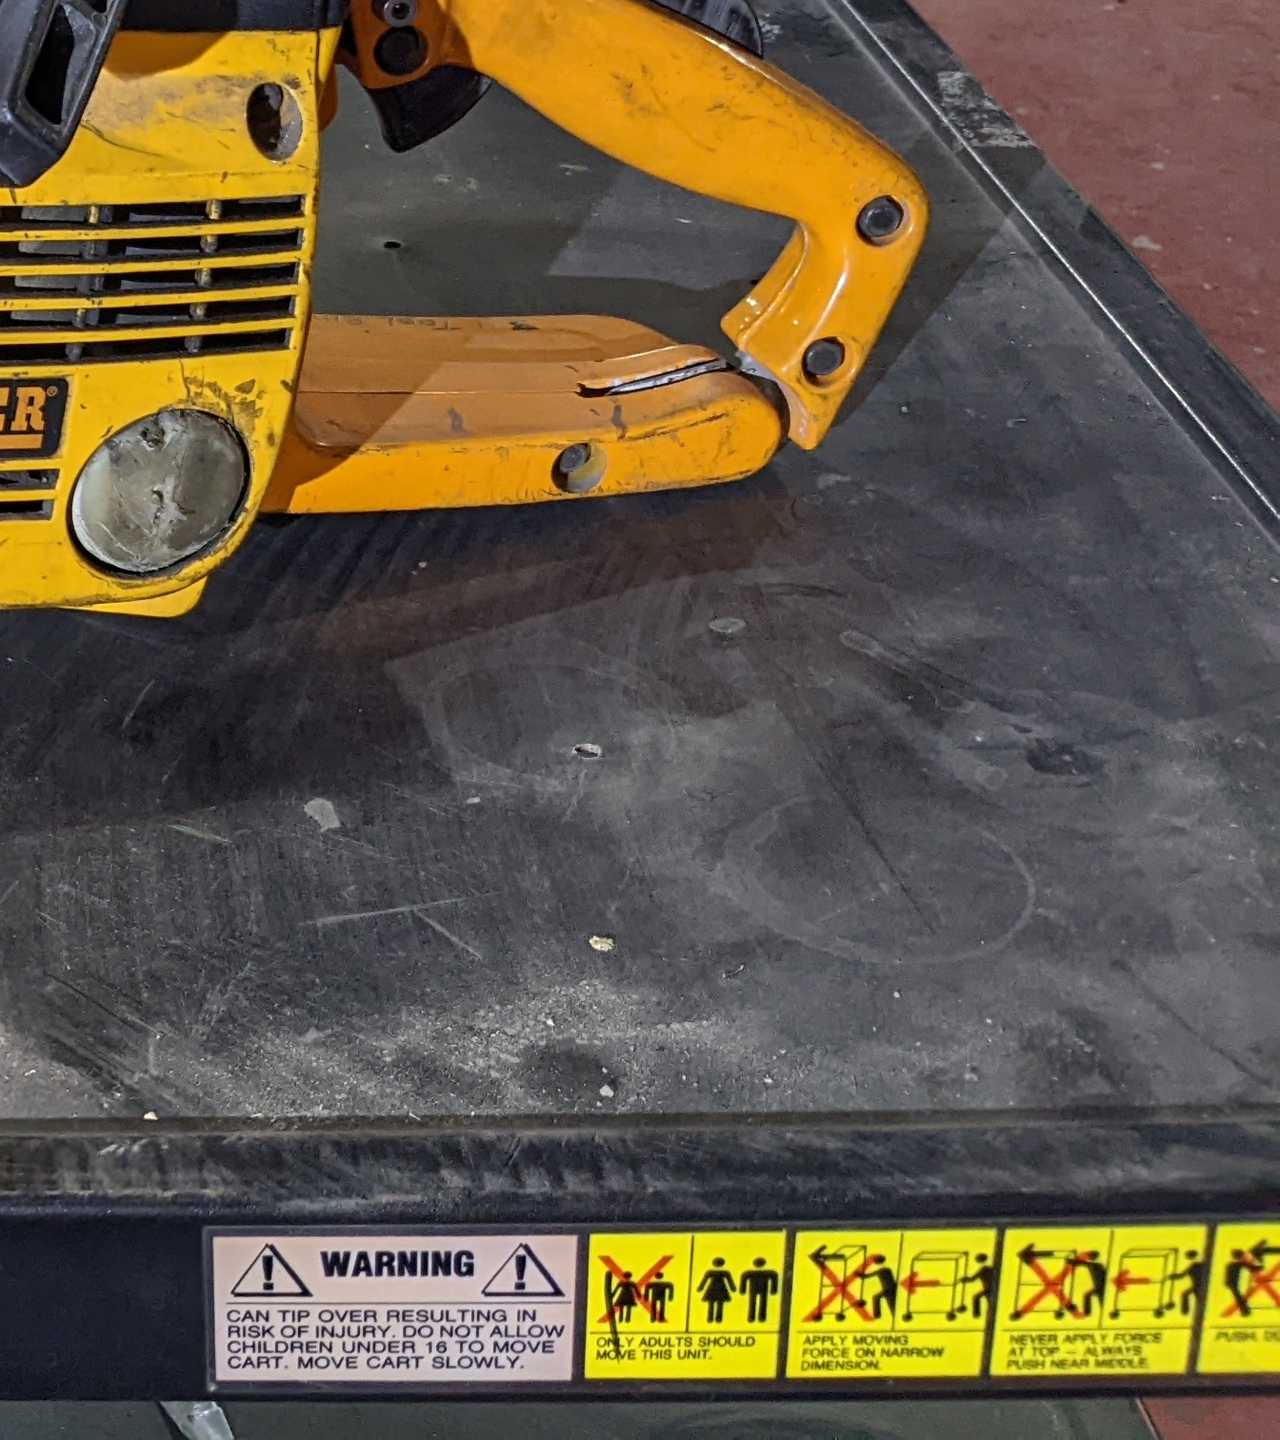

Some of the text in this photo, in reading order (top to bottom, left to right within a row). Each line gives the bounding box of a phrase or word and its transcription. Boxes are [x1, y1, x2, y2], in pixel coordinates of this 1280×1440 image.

[320, 1250, 475, 1278] WARNING
[227, 1310, 536, 1323] CAN TIP OVER RESULTING IN
[228, 1325, 565, 1338] RISK OF INJURY. DO NOT ALLOW
[596, 1336, 756, 1347] ONLY ADULTS SHOULD
[803, 1335, 909, 1345] APPLY MOVING
[1009, 1332, 1162, 1345] NEVER APPLY FORCE
[227, 1341, 554, 1354] CHILDREN UNDER 16 TO MOVE
[802, 1347, 944, 1358] FORCE ON NARROW
[1009, 1345, 1143, 1357] AT TOP ALWAYS
[595, 1349, 713, 1360] MOVE THIS UNIT.
[227, 1356, 525, 1369] CART. MOVE CART SLOWLY.
[1007, 1359, 1045, 1370] PUSH
[1050, 1359, 1090, 1369] NEAR
